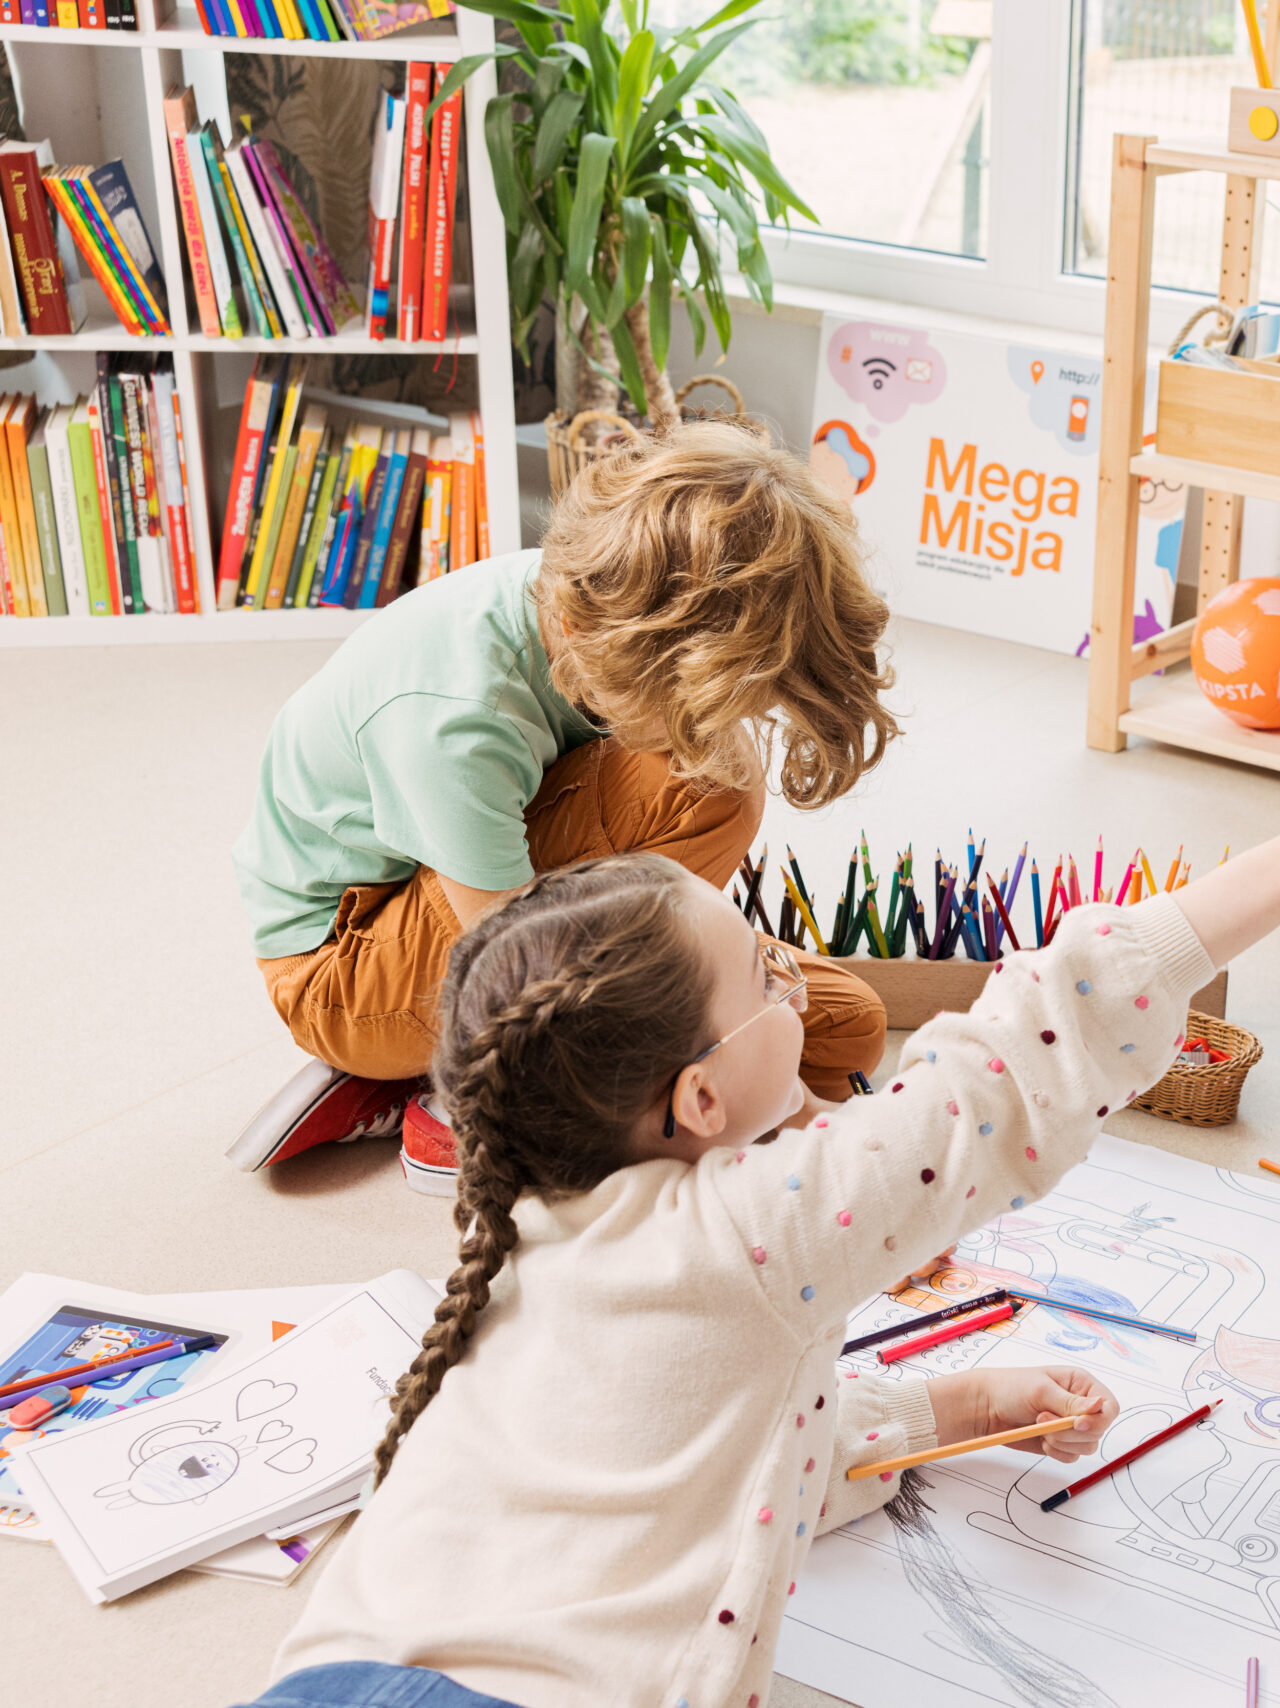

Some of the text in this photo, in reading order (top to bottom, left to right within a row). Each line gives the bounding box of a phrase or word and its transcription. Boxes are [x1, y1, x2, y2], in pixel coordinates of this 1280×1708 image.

[13, 183, 29, 221] Dumas
[173, 137, 211, 297] Antologia poezji dla dzieci
[123, 380, 142, 449] GUINNESS
[131, 450, 147, 497] WORLD
[925, 437, 1080, 522] Mega
[919, 493, 1063, 576] Misja
[1199, 677, 1266, 701] KIPSTA
[365, 1366, 393, 1393] Fundac
